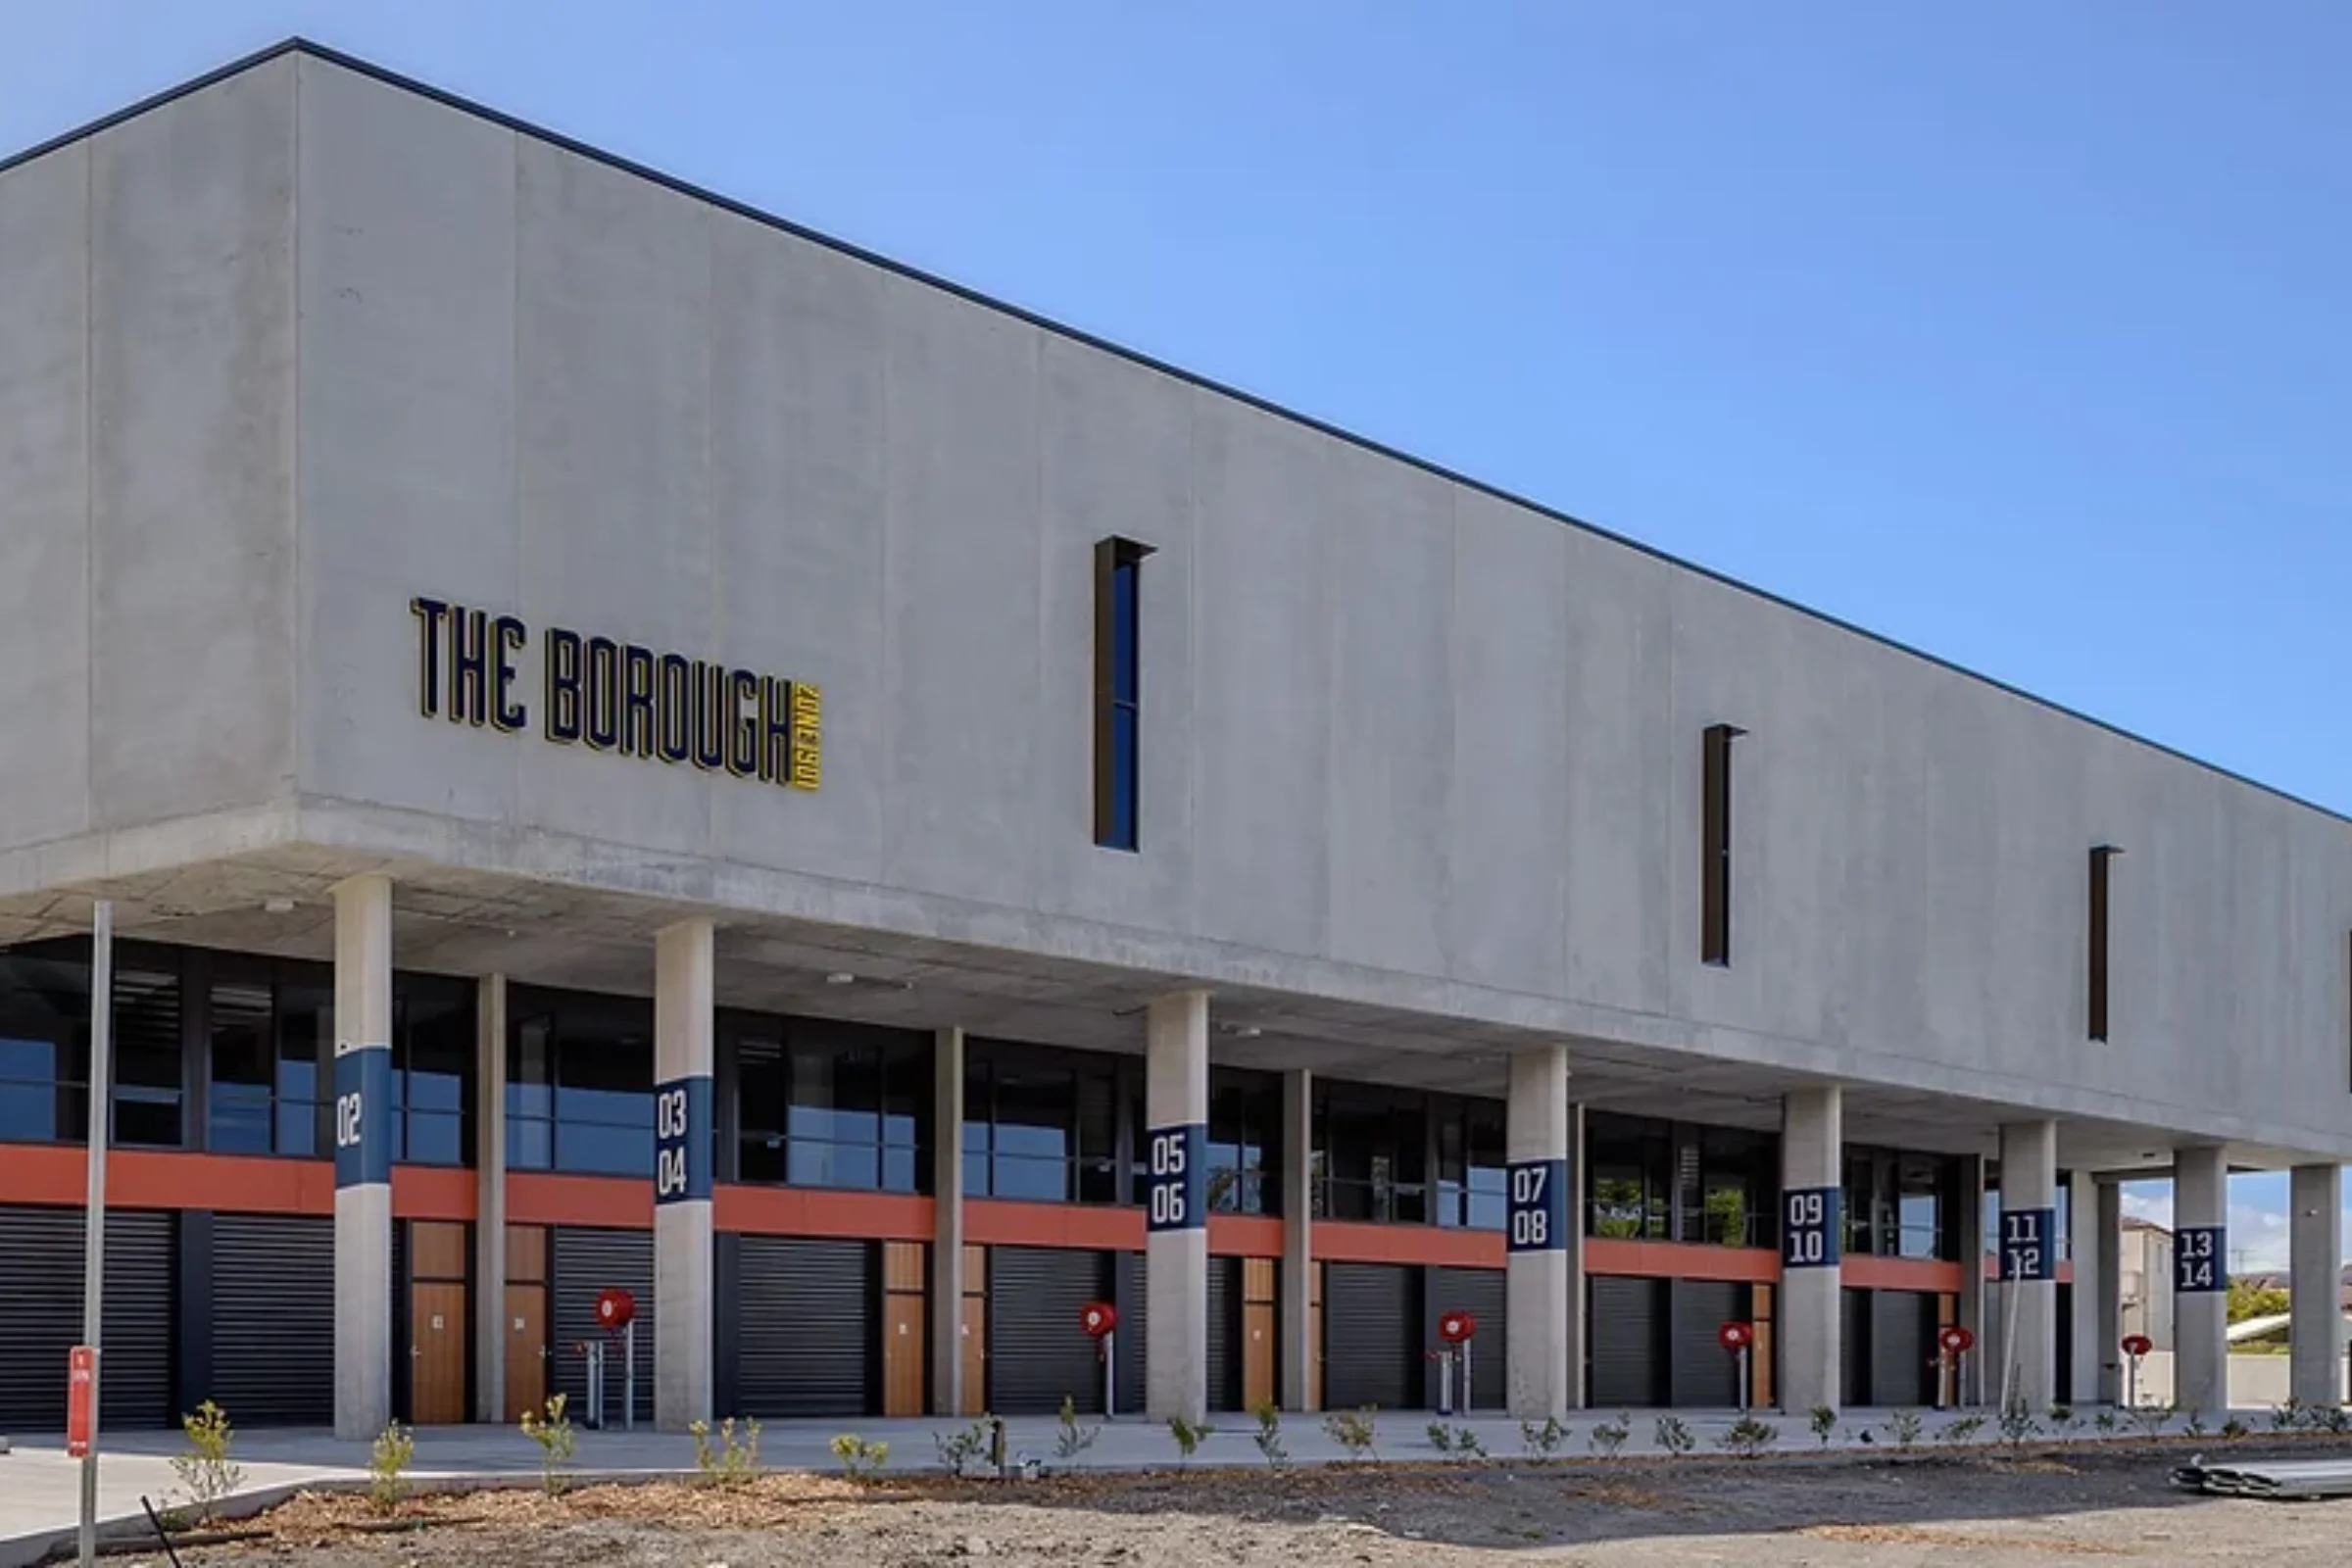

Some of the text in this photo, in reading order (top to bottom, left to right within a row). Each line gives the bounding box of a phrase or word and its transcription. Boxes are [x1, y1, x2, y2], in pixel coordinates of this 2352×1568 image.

[410, 597, 792, 787] THE BOROUGH
[337, 1093, 361, 1147] 02
[659, 1090, 686, 1139] 03
[659, 1147, 686, 1195] 04
[1152, 1134, 1185, 1175] 05
[1514, 1166, 1546, 1202] 07
[1152, 1183, 1185, 1223] 06
[1790, 1194, 1823, 1225] 09
[1514, 1209, 1546, 1244] 08
[2007, 1215, 2038, 1244] 11
[1789, 1231, 1823, 1262] 10
[2007, 1247, 2038, 1276] 12
[2181, 1231, 2213, 1258] 13
[2181, 1261, 2213, 1287] 14
